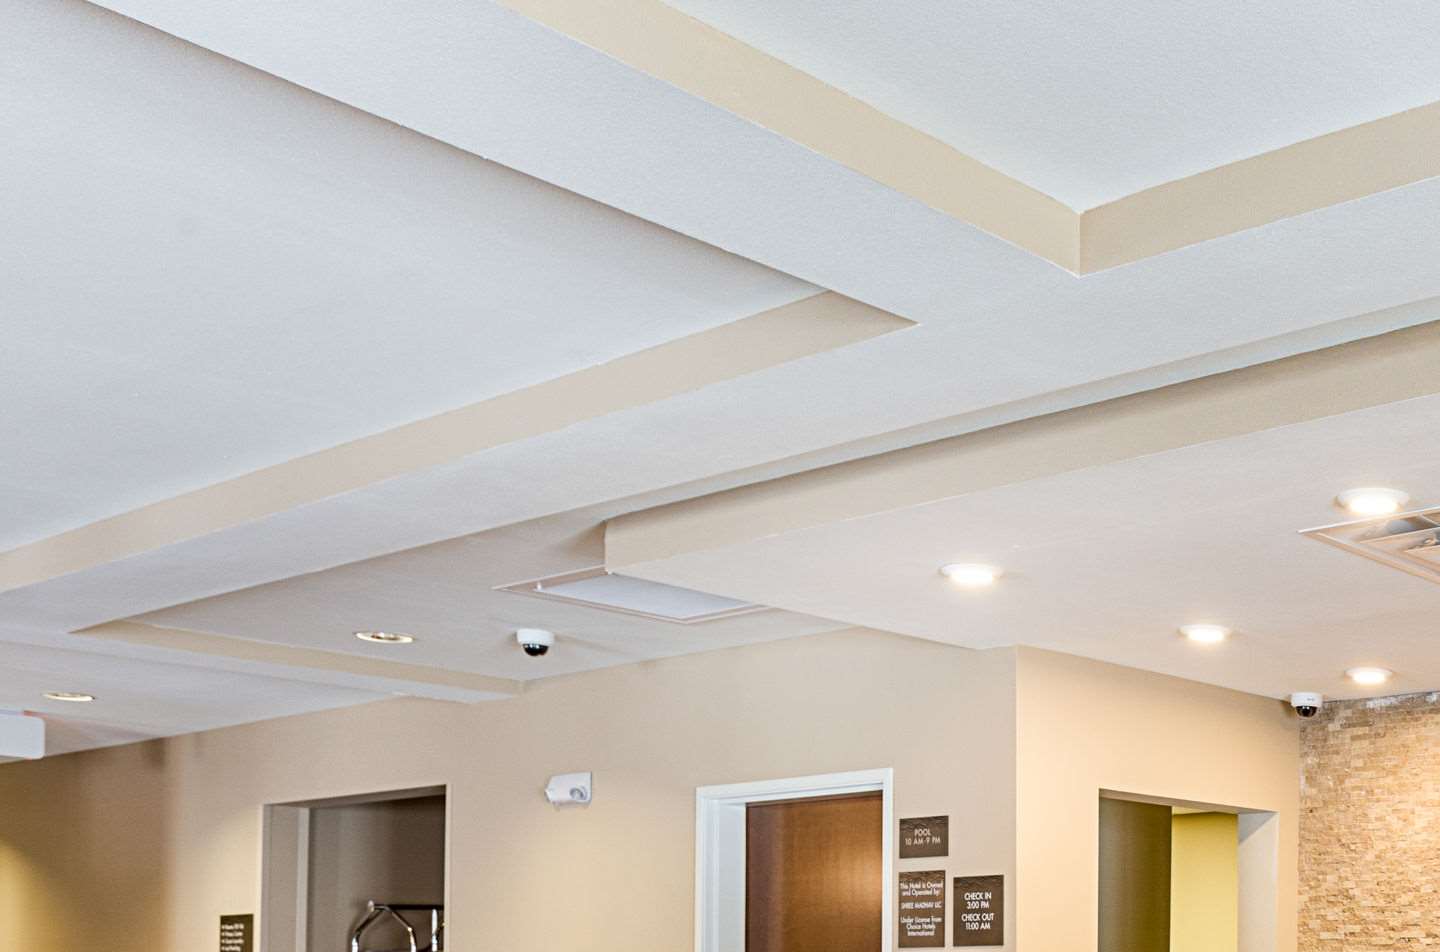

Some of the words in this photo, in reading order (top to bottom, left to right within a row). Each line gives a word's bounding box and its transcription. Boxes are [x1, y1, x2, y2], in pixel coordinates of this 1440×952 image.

[914, 828, 931, 837] POOL
[905, 838, 912, 846] 10
[932, 836, 941, 844] PM
[964, 892, 984, 901] CHECK
[984, 891, 992, 900] IN
[966, 901, 980, 910] 3:00
[980, 900, 990, 909] PM
[961, 913, 981, 922] CHECK
[981, 912, 995, 921] OUT
[965, 922, 980, 931] 11:00
[980, 921, 991, 930] AM
